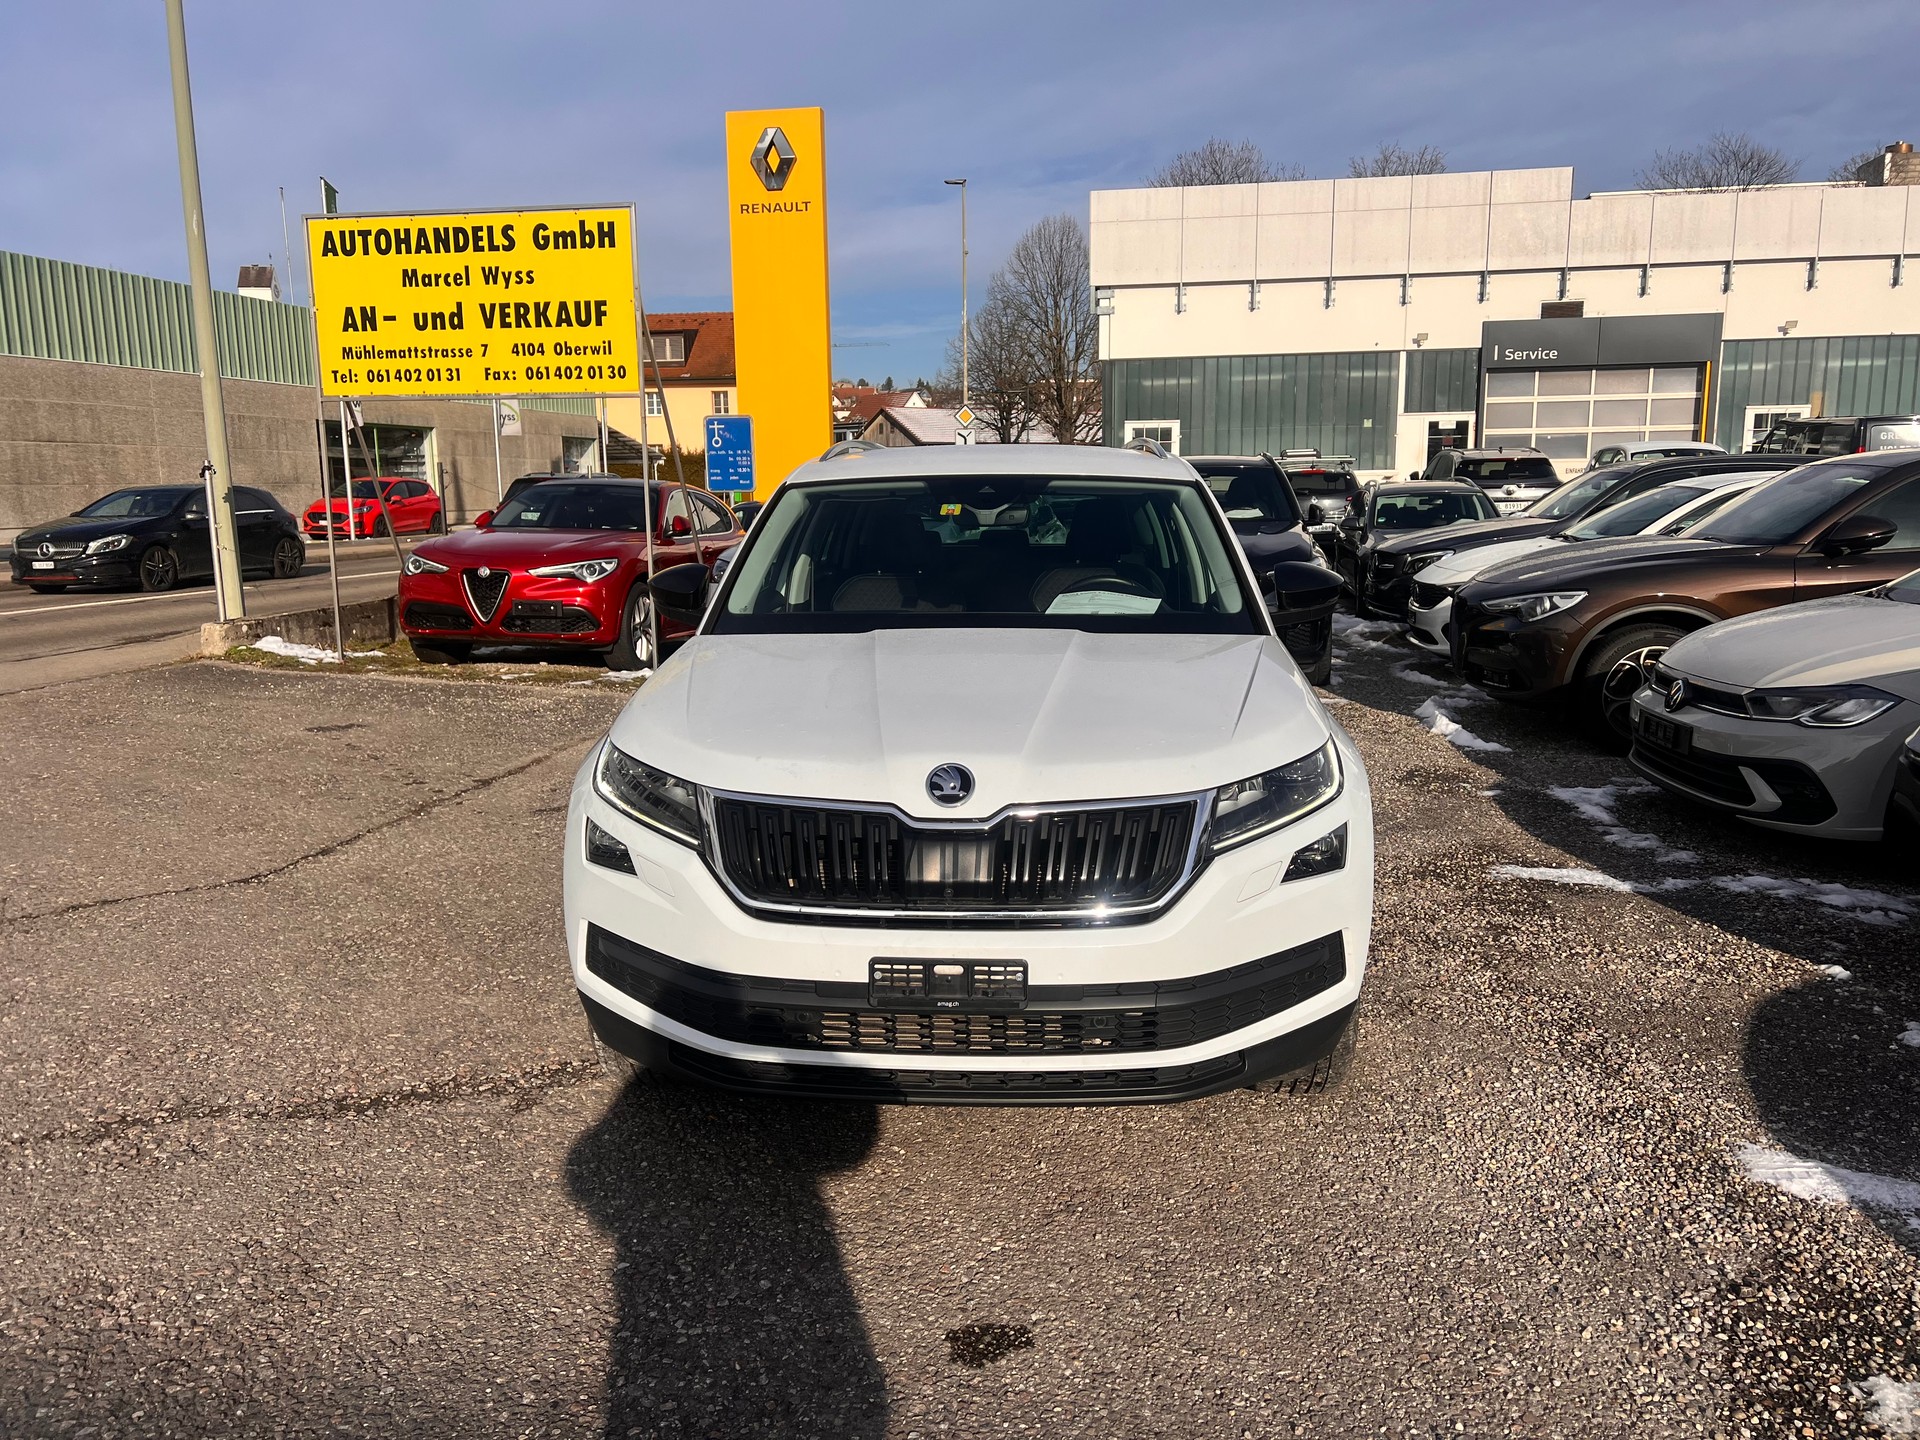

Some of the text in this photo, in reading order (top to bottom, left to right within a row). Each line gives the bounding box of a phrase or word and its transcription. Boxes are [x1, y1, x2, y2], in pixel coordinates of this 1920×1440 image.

[740, 201, 811, 214] RENAULT
[322, 220, 616, 257] AUTOHANDELS GmbH
[402, 266, 535, 290] Marcel Wyss
[413, 302, 464, 331] und
[479, 300, 608, 329] VERKAUF
[342, 344, 489, 360] Mühlemattstrasse 7
[511, 340, 612, 357] 4104 Oberwil
[1505, 347, 1558, 360] Service
[331, 369, 359, 384] Tel:
[485, 367, 517, 381] Fax:
[500, 414, 516, 429] yss
